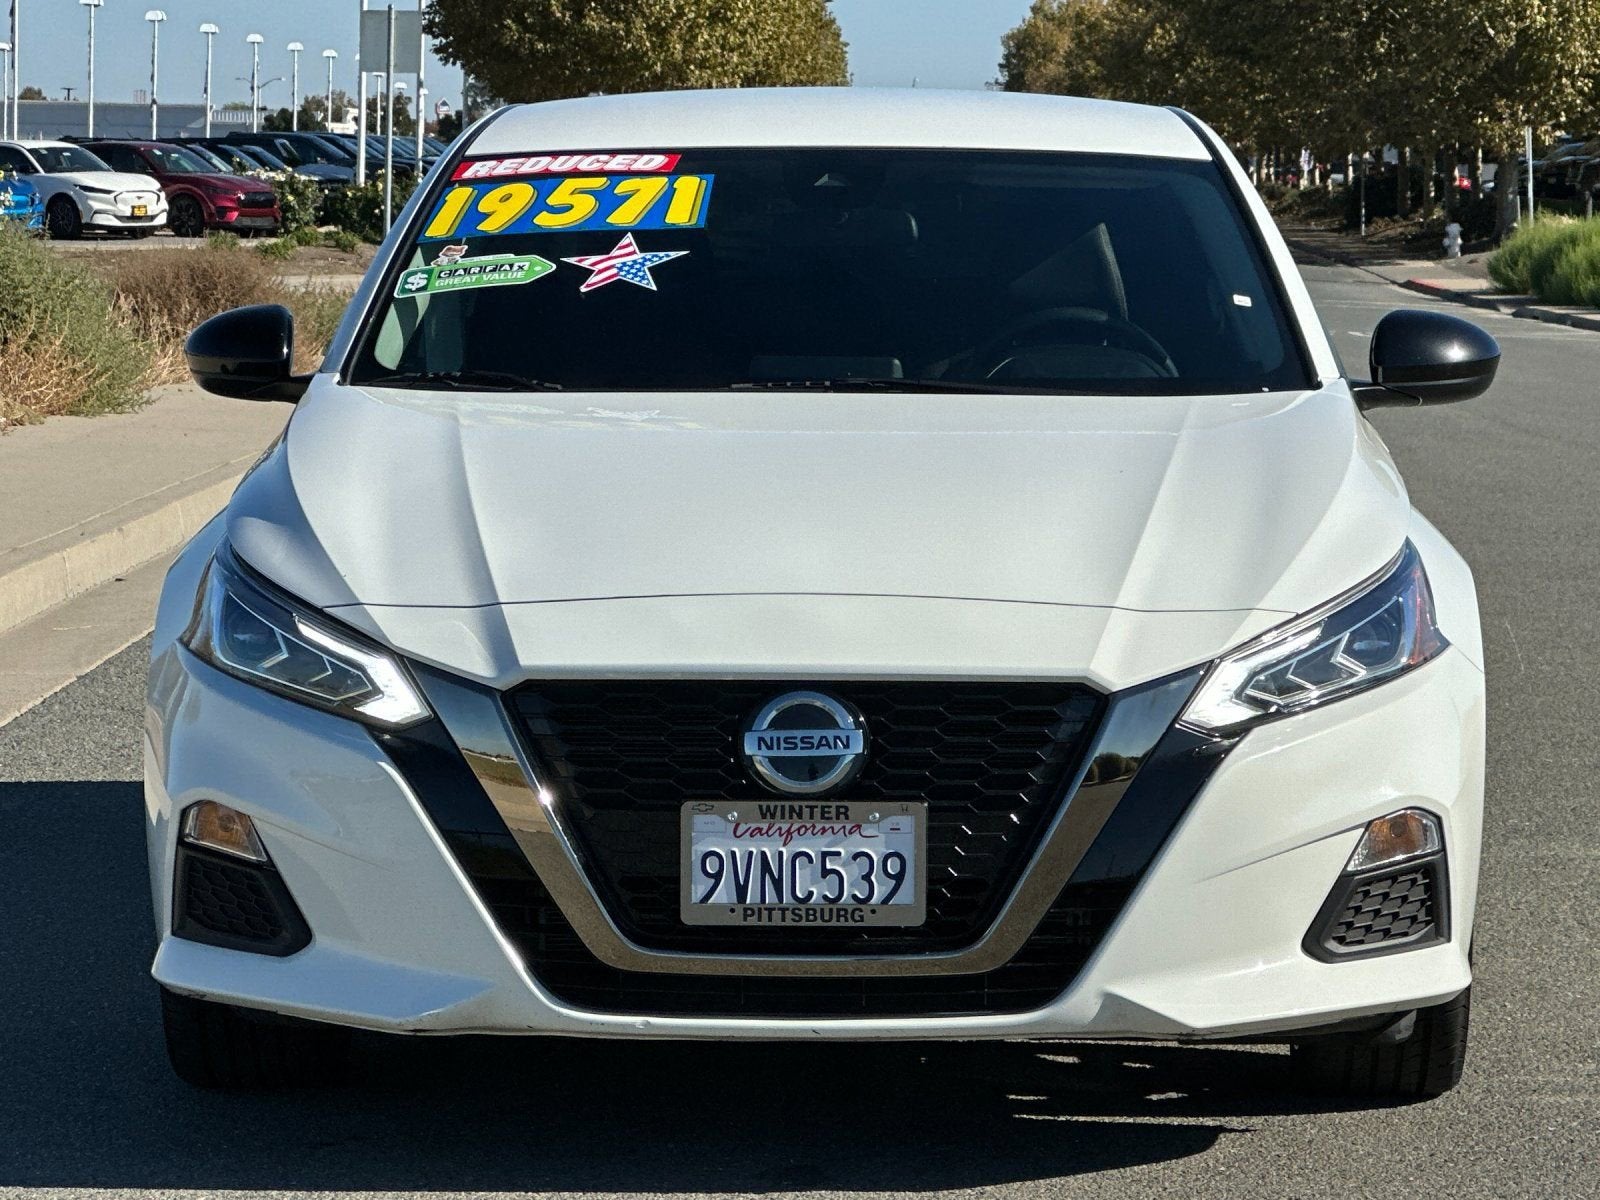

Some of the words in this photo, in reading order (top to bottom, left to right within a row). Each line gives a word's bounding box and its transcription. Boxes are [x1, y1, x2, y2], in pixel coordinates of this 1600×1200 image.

[461, 154, 668, 178] REDUCED
[424, 175, 707, 238] 19571
[435, 274, 478, 287] GREAT
[482, 271, 526, 282] VALUE
[438, 262, 531, 279] CARFAX
[757, 734, 851, 751] NISSAN
[757, 804, 850, 820] WINTER
[732, 822, 879, 847] California
[699, 850, 907, 905] 9VNC539
[742, 907, 865, 923] PITTSBURG
